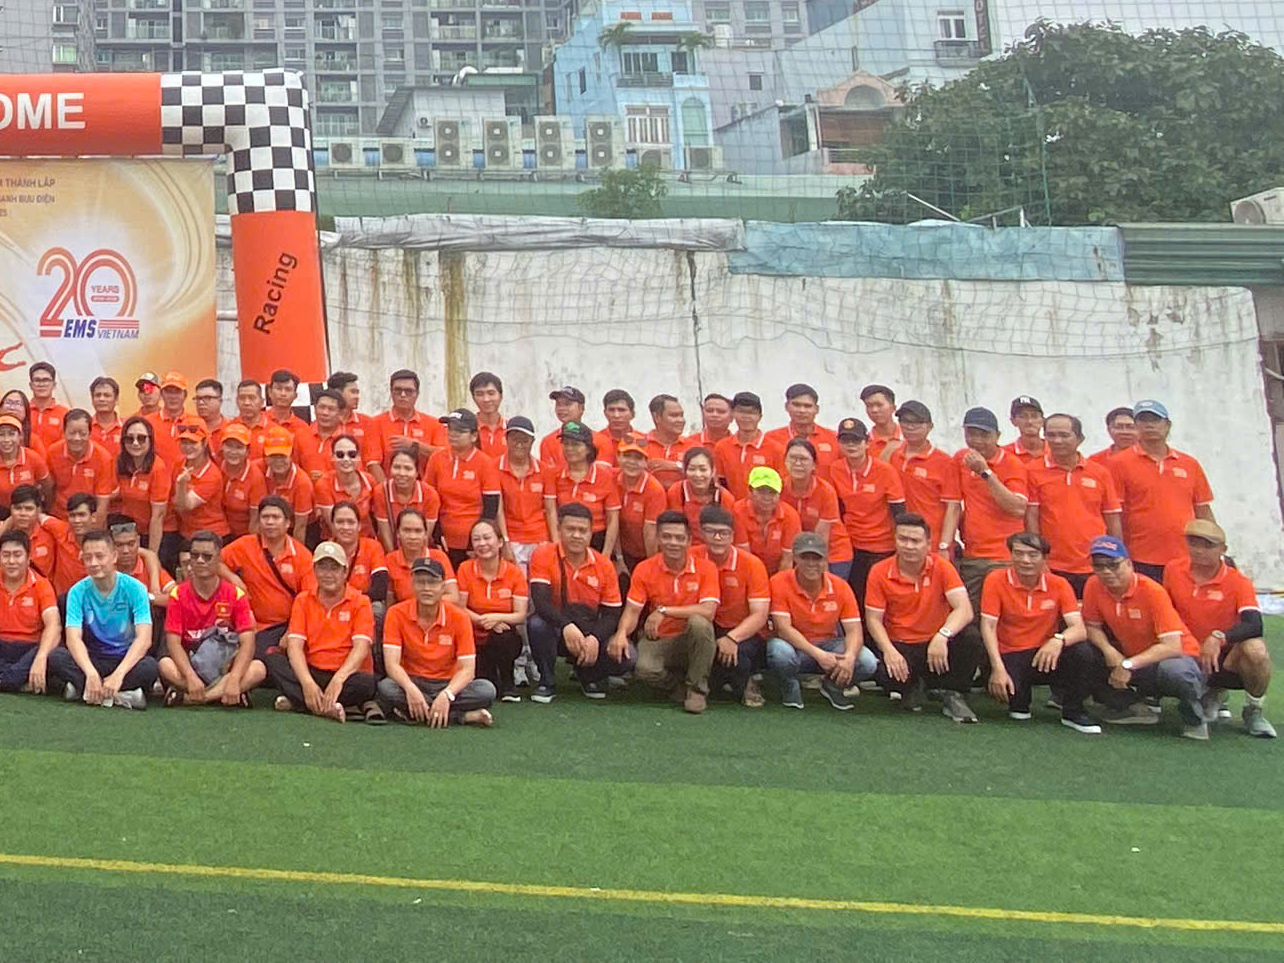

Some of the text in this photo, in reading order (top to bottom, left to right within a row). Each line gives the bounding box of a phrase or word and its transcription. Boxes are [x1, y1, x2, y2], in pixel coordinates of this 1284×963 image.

[36, 247, 138, 338] 20
[91, 285, 120, 294] YEARS
[253, 252, 298, 335] Racing
[63, 318, 140, 339] EMS VIETNAM
